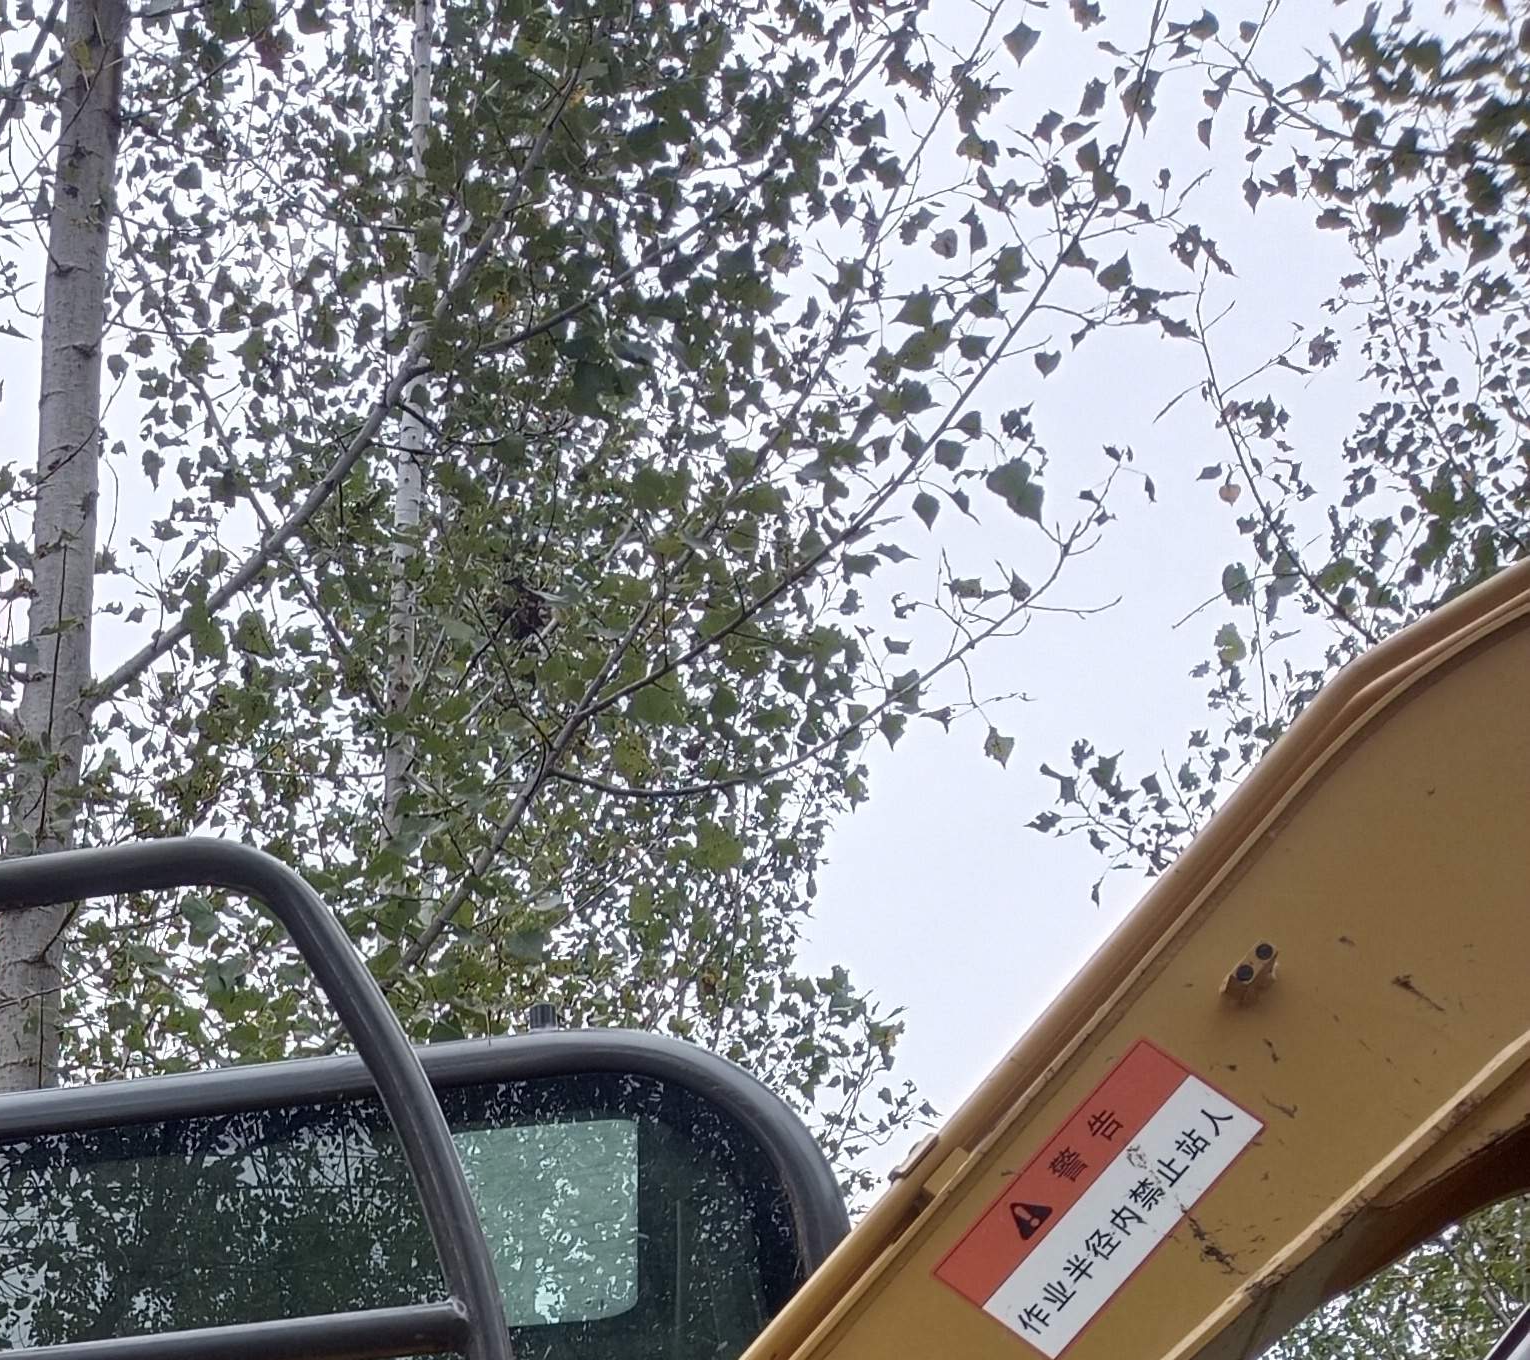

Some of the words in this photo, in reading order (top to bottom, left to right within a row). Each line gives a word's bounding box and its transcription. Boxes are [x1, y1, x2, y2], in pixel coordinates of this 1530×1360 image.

[1016, 1106, 1234, 1335] 作业半径内禁止站人
[1047, 1108, 1125, 1183] 警告
